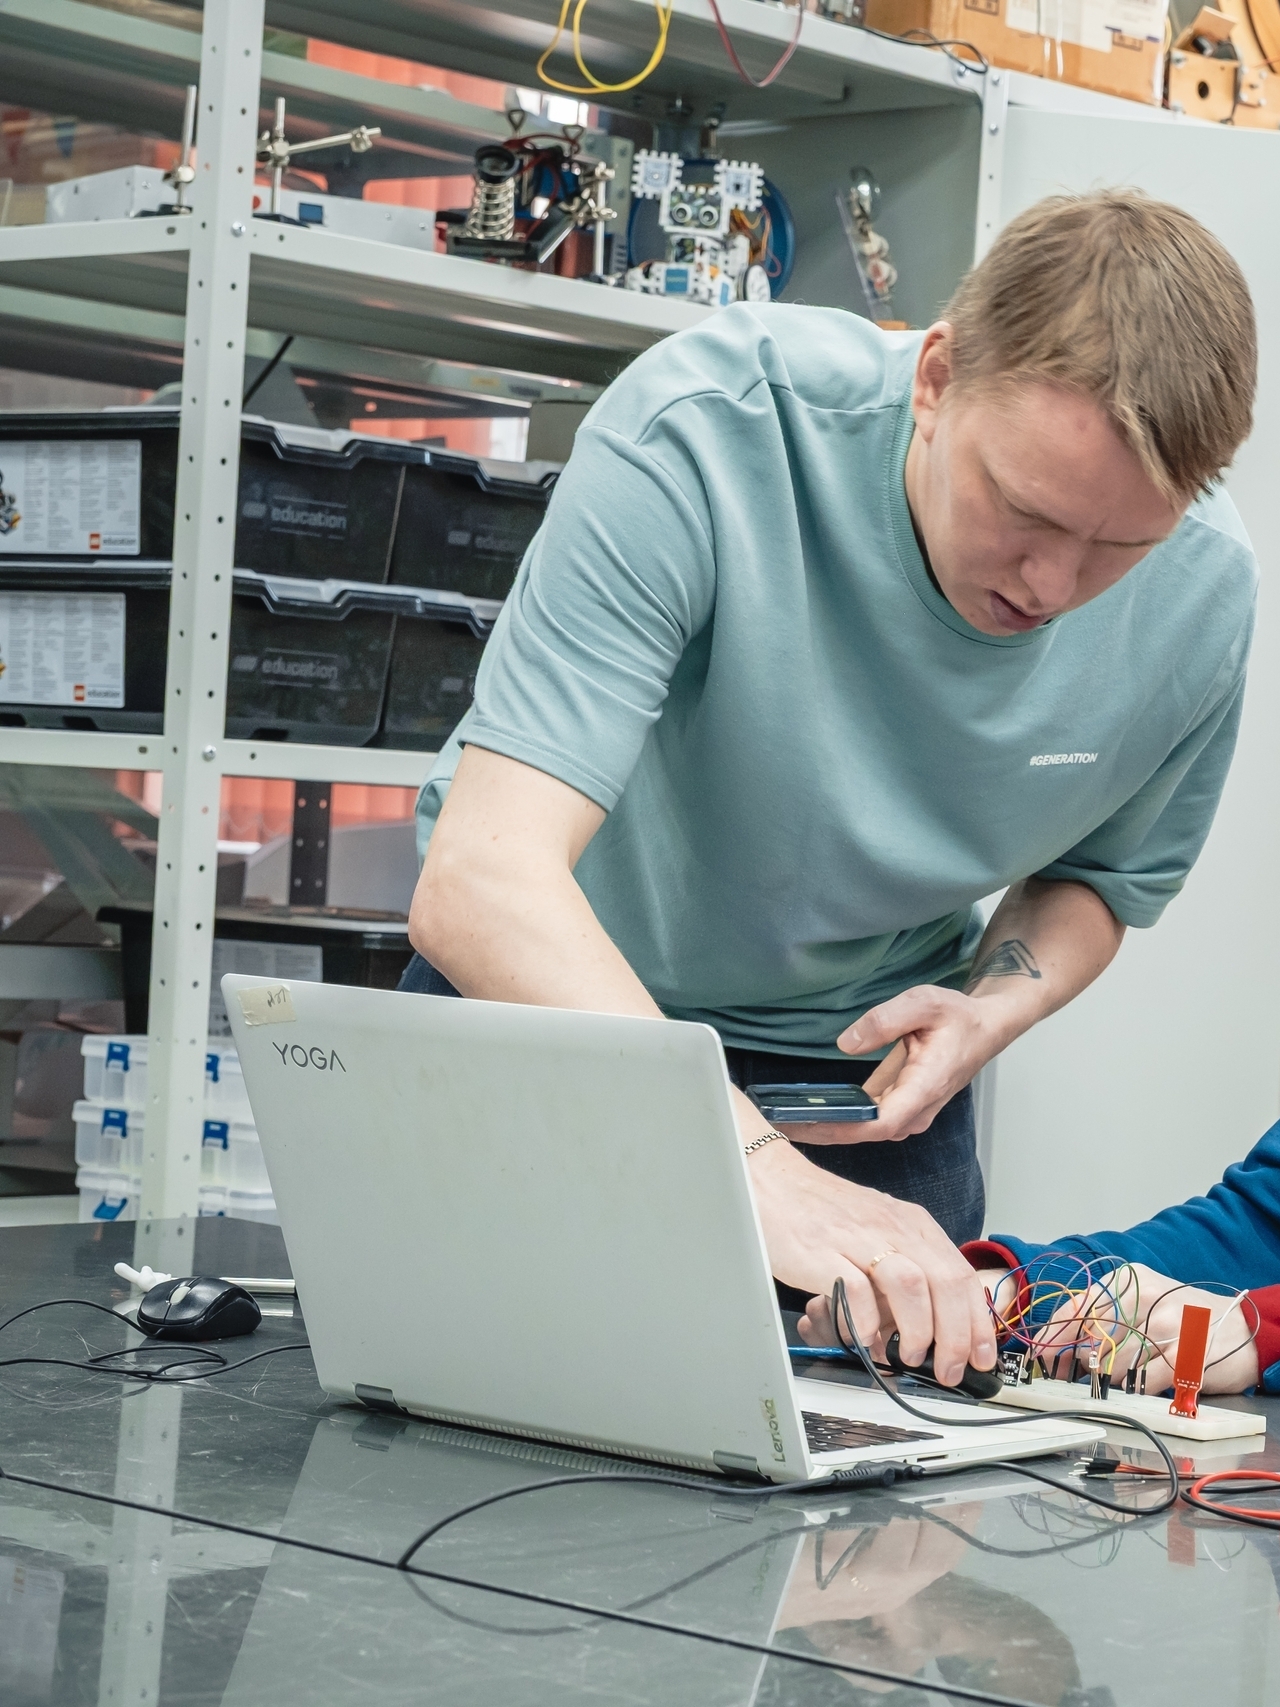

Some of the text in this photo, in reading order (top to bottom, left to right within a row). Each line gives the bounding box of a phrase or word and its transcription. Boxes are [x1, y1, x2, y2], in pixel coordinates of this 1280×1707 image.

[270, 504, 347, 529] education
[262, 656, 338, 680] education
[1029, 753, 1099, 766] #GENERATION
[272, 1041, 347, 1072] YOGA
[765, 1399, 786, 1462] Lenovo
